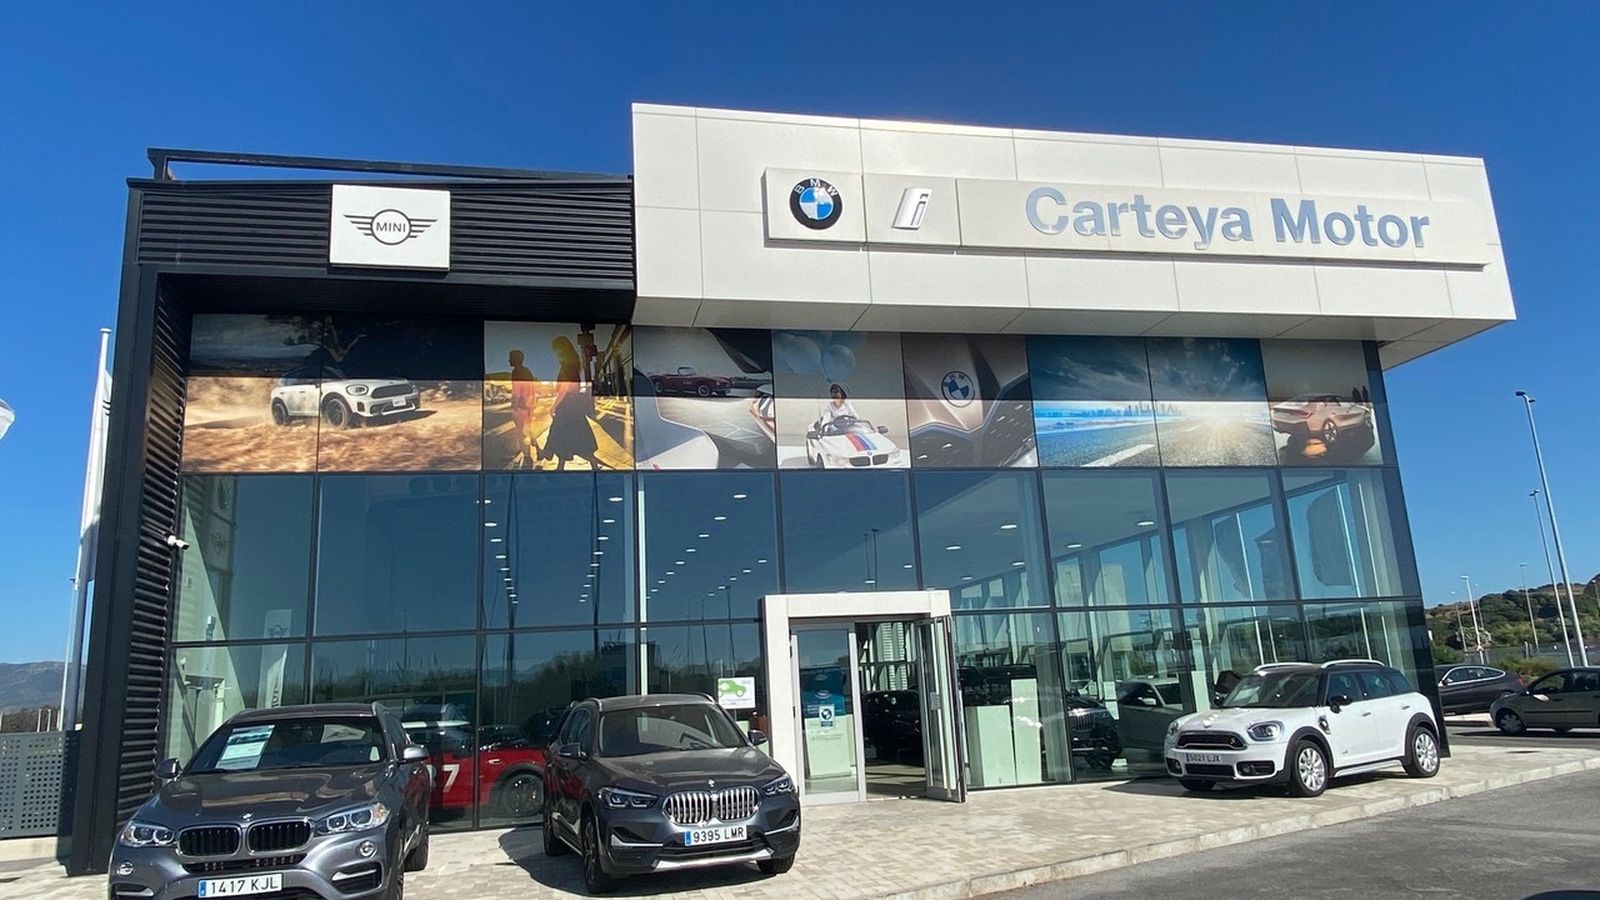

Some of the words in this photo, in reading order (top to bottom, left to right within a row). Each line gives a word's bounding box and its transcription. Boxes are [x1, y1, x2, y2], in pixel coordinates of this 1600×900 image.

[794, 178, 838, 196] BMW
[1024, 186, 1254, 250] Carteya
[1270, 198, 1430, 248] Motor
[376, 222, 406, 232] MINI
[693, 830, 720, 842] 9395
[724, 827, 744, 839] LMR
[212, 880, 246, 894] 1417
[251, 877, 278, 891] KJL
